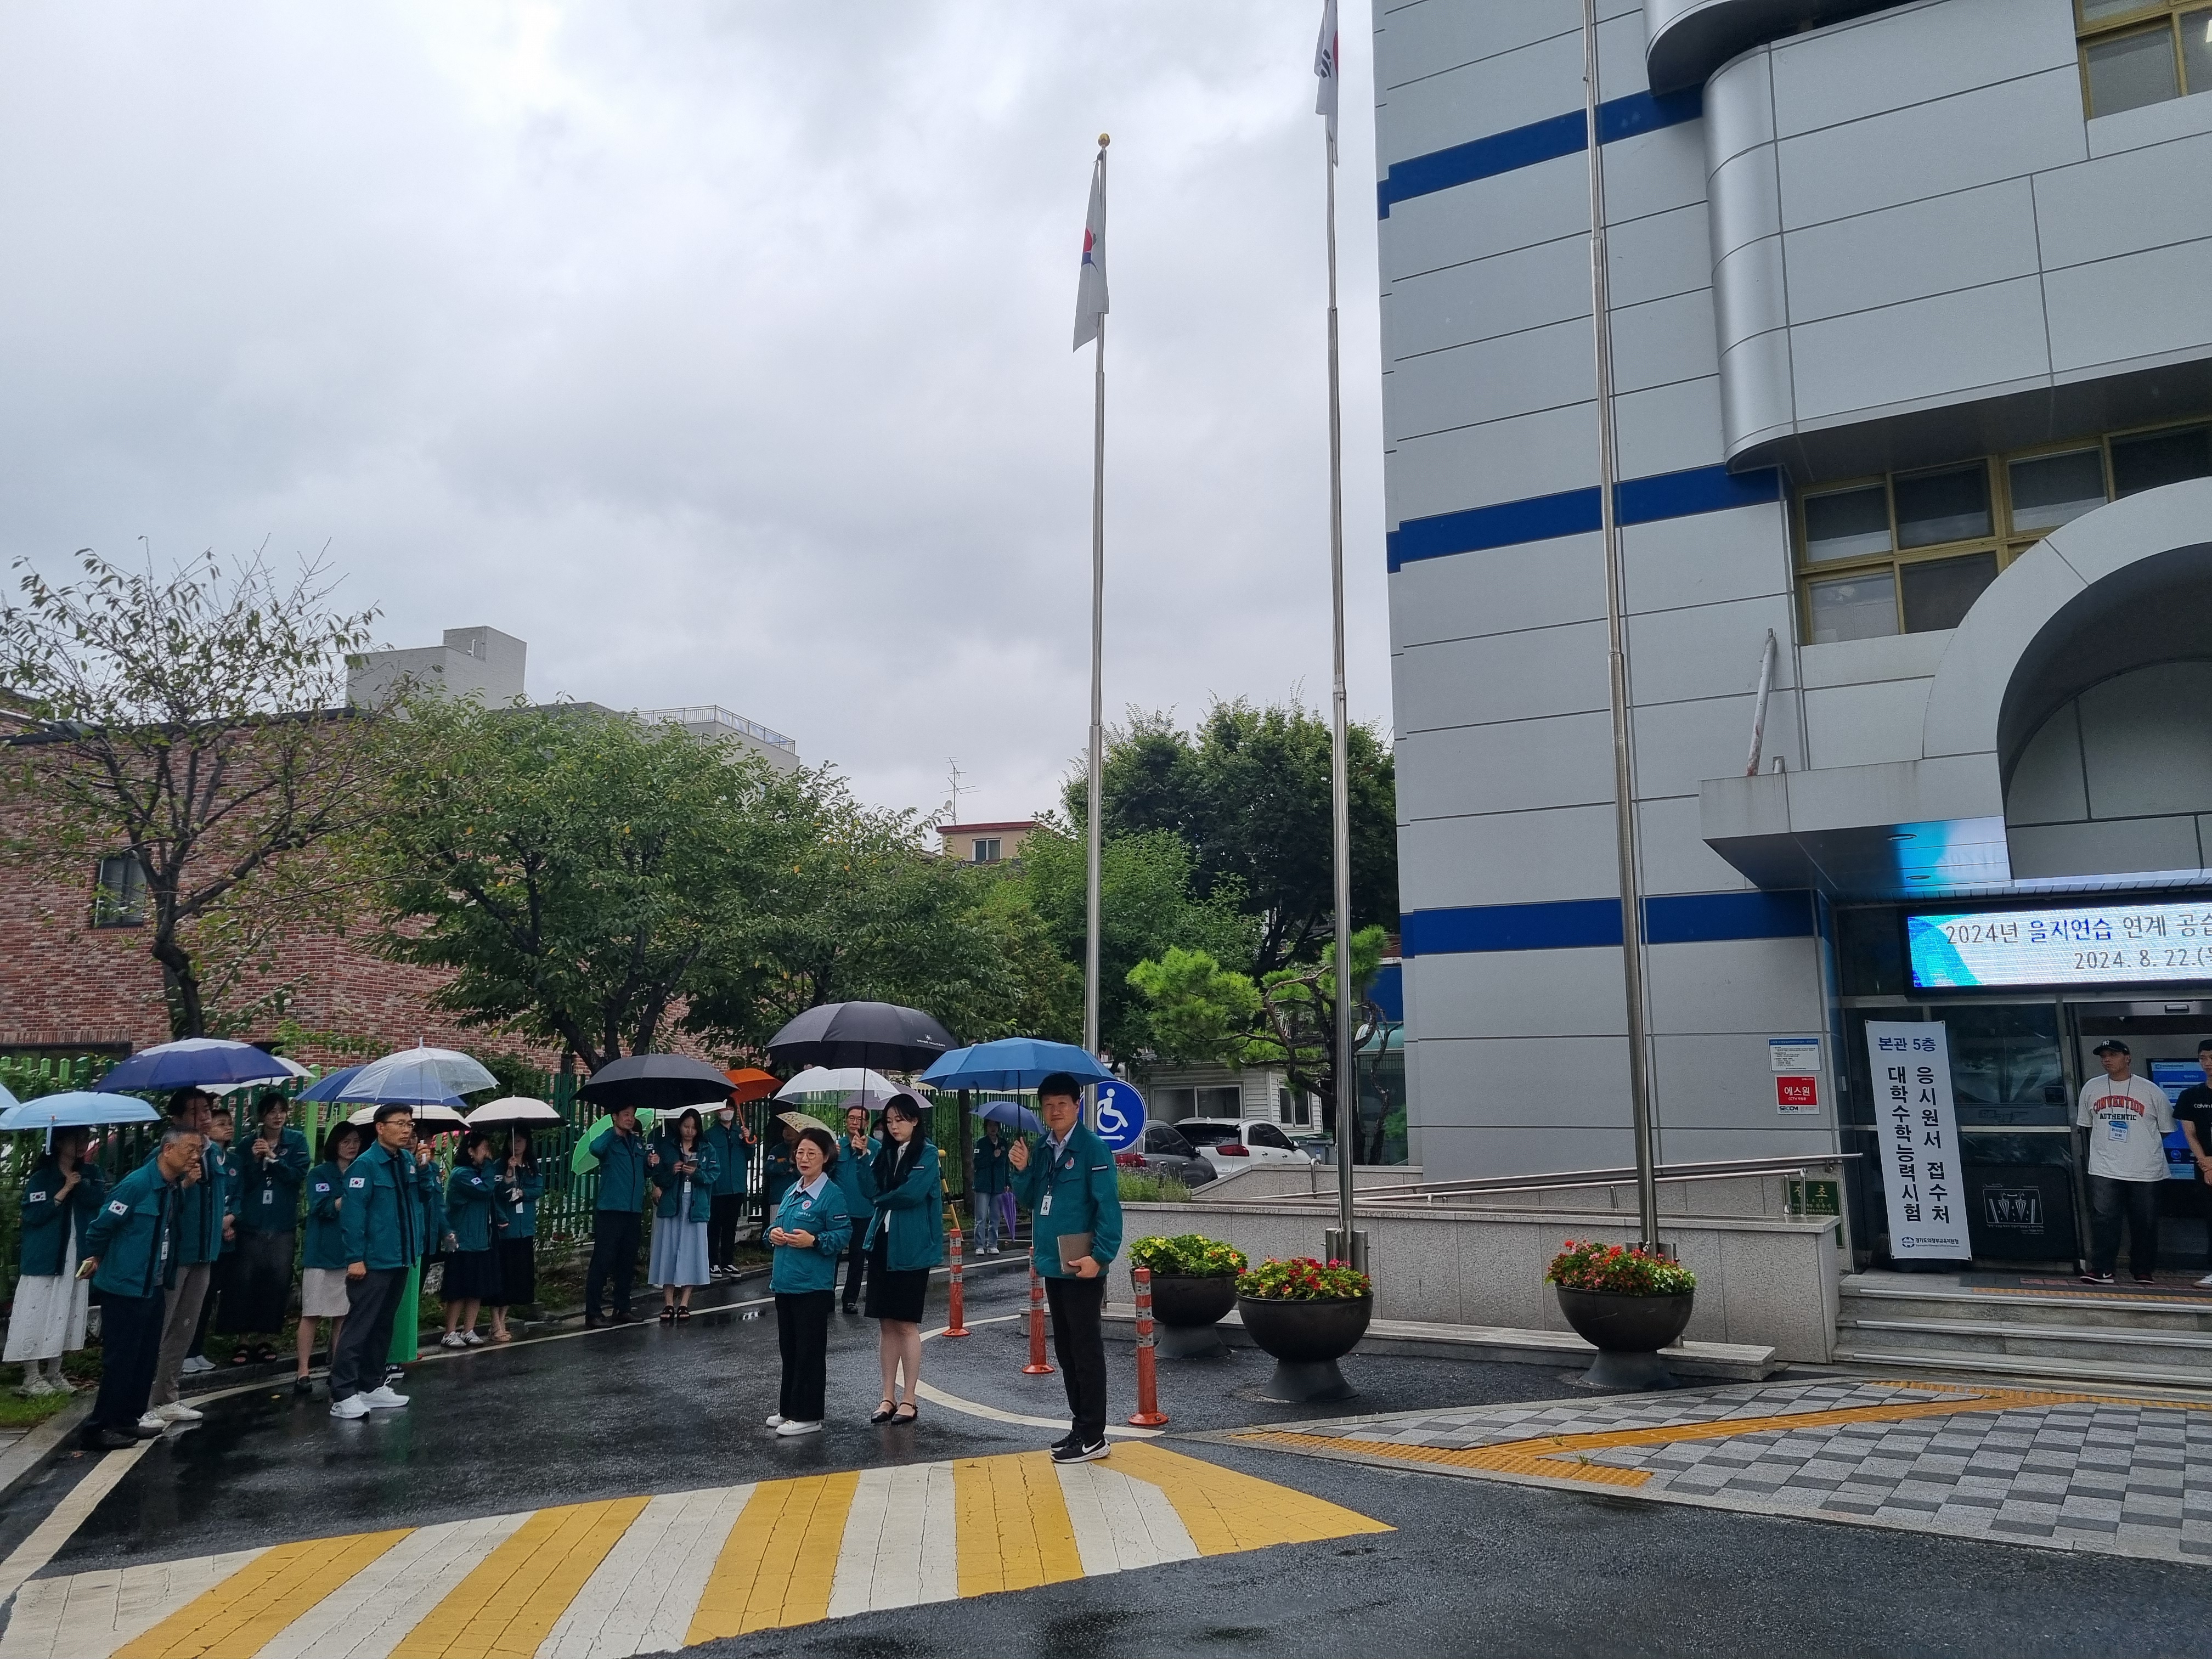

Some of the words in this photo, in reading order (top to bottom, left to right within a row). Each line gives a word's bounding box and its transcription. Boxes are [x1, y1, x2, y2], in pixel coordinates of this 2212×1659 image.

[1946, 922, 2018, 944] 2024년
[2028, 918, 2112, 944] 을지연습
[2123, 915, 2166, 938] 연계
[2074, 950, 2131, 969] 2024.
[2140, 950, 2158, 967] 8.
[1878, 1037, 1908, 1051] 본관
[1913, 1037, 1936, 1052] 5층
[1784, 1086, 1810, 1096] 에스원
[1916, 1066, 1942, 1149] 응시원서
[2093, 1095, 2145, 1118] CONVENTION
[2100, 1113, 2137, 1121] AUTHENTIC
[1887, 1066, 1921, 1222] 대학수학능력시험
[1927, 1161, 1950, 1224] 접수처
